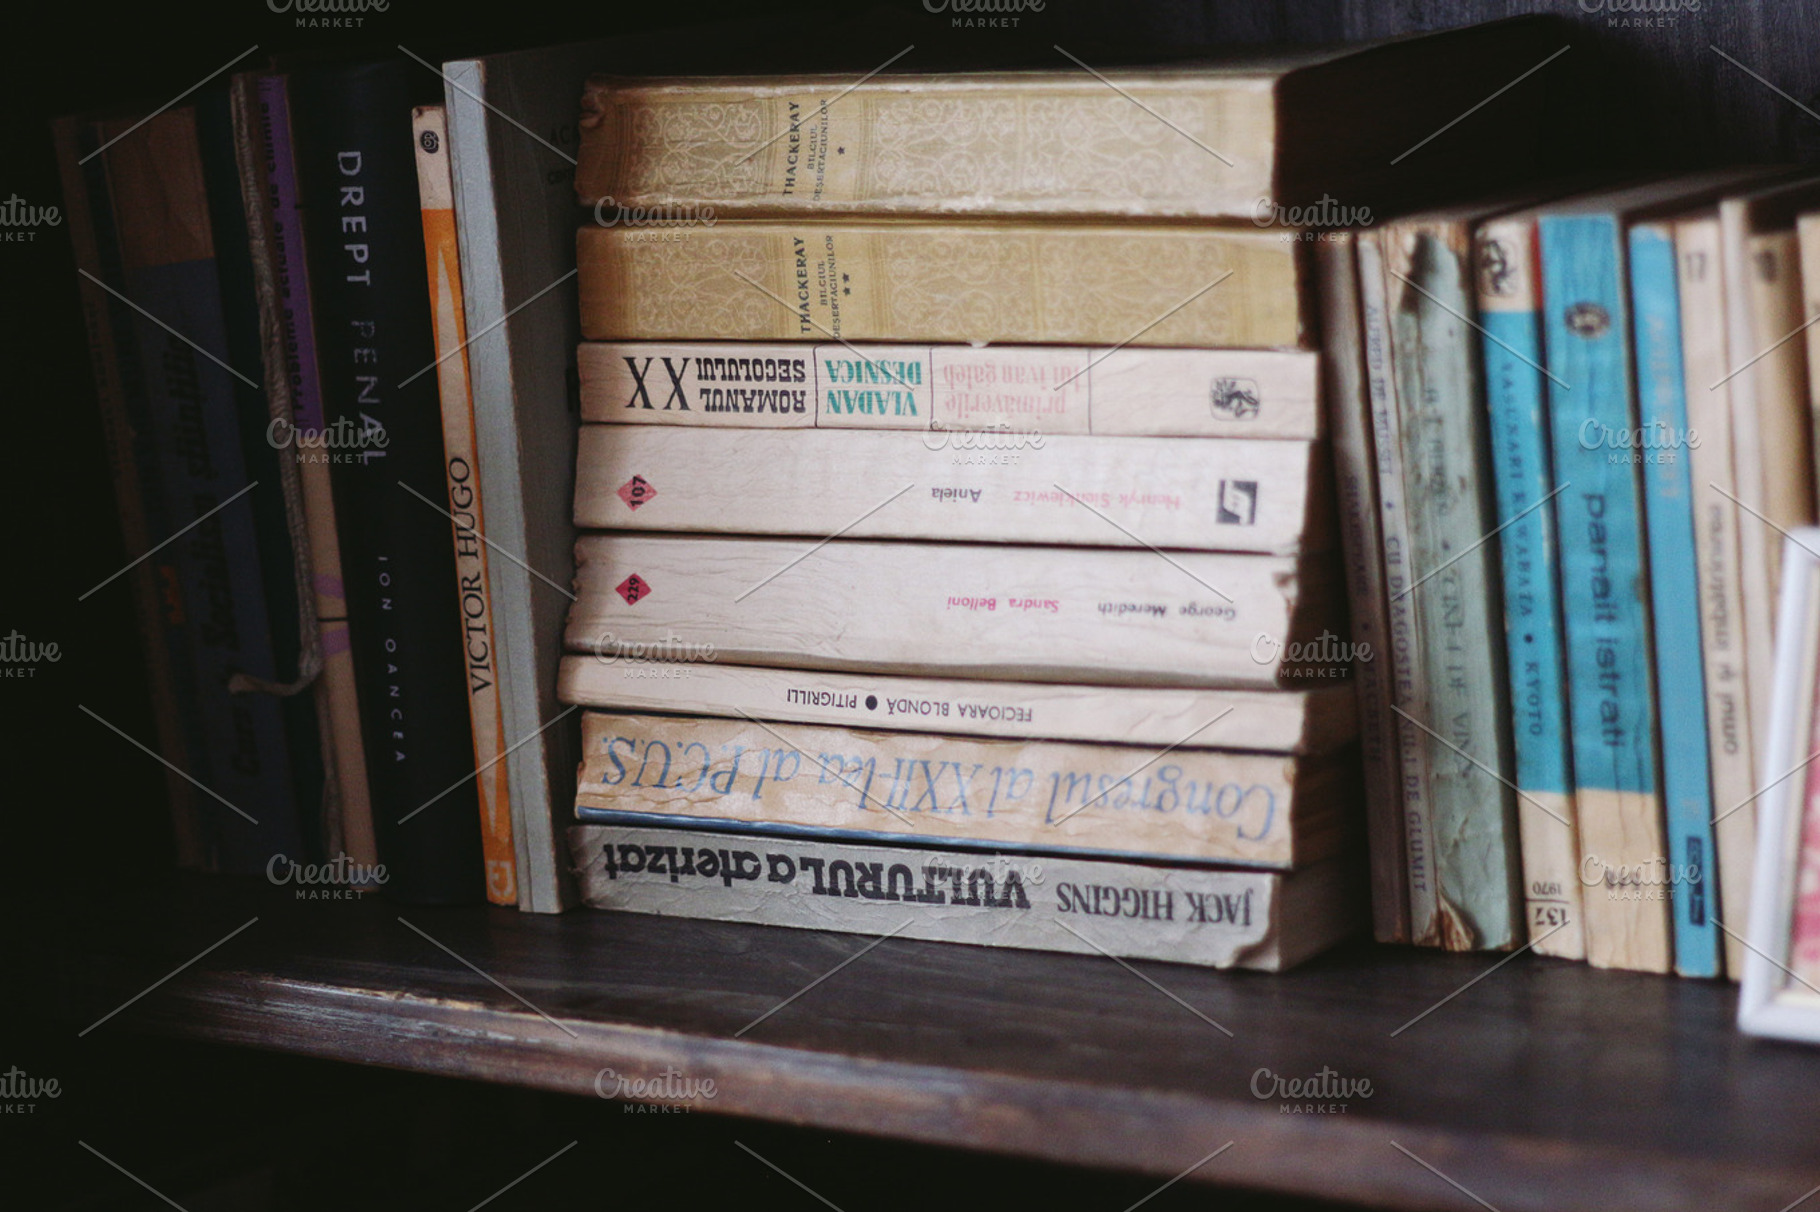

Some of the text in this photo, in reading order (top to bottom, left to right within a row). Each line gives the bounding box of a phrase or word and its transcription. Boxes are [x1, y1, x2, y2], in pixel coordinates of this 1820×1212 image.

[782, 101, 800, 197] THACKERAY
[806, 123, 818, 171] BILCIUL
[796, 236, 811, 335] THACKERAY
[818, 260, 828, 306] BILCIUL
[336, 150, 388, 466] DREPT PENAL
[622, 356, 692, 412] XX
[695, 358, 806, 382] SECOLULUI
[823, 359, 923, 385] DESNICA
[943, 362, 996, 389] galeb
[1001, 364, 1047, 390] ivan
[699, 388, 807, 414] ROMANUL
[825, 389, 918, 416] VLADAN
[628, 475, 647, 508] 107
[931, 486, 983, 504] Aniela
[1118, 489, 1183, 510] Henryk
[1387, 536, 1401, 565] CU
[448, 457, 493, 696] VICTOR HUGO
[626, 576, 641, 601] 229
[946, 595, 1237, 621] George Meredith Sandra Belloni
[1581, 492, 1626, 748] panait istrati
[377, 556, 406, 763] ION OANCEA
[1388, 576, 1413, 705] DRAGOSTEA
[787, 688, 1033, 722] FECIOARA BLONDĂ PITIGRILLI
[1524, 661, 1543, 737] KYOTO
[751, 747, 802, 801] al
[985, 766, 1035, 819] al
[1405, 775, 1420, 802] DE
[1044, 764, 1276, 842] Congresul
[1408, 811, 1428, 892] GLUMIT
[602, 843, 1254, 927] JACK HIGGINS VULTURUL a aterizat
[1531, 882, 1564, 896] 1970
[1534, 905, 1569, 927] 137
